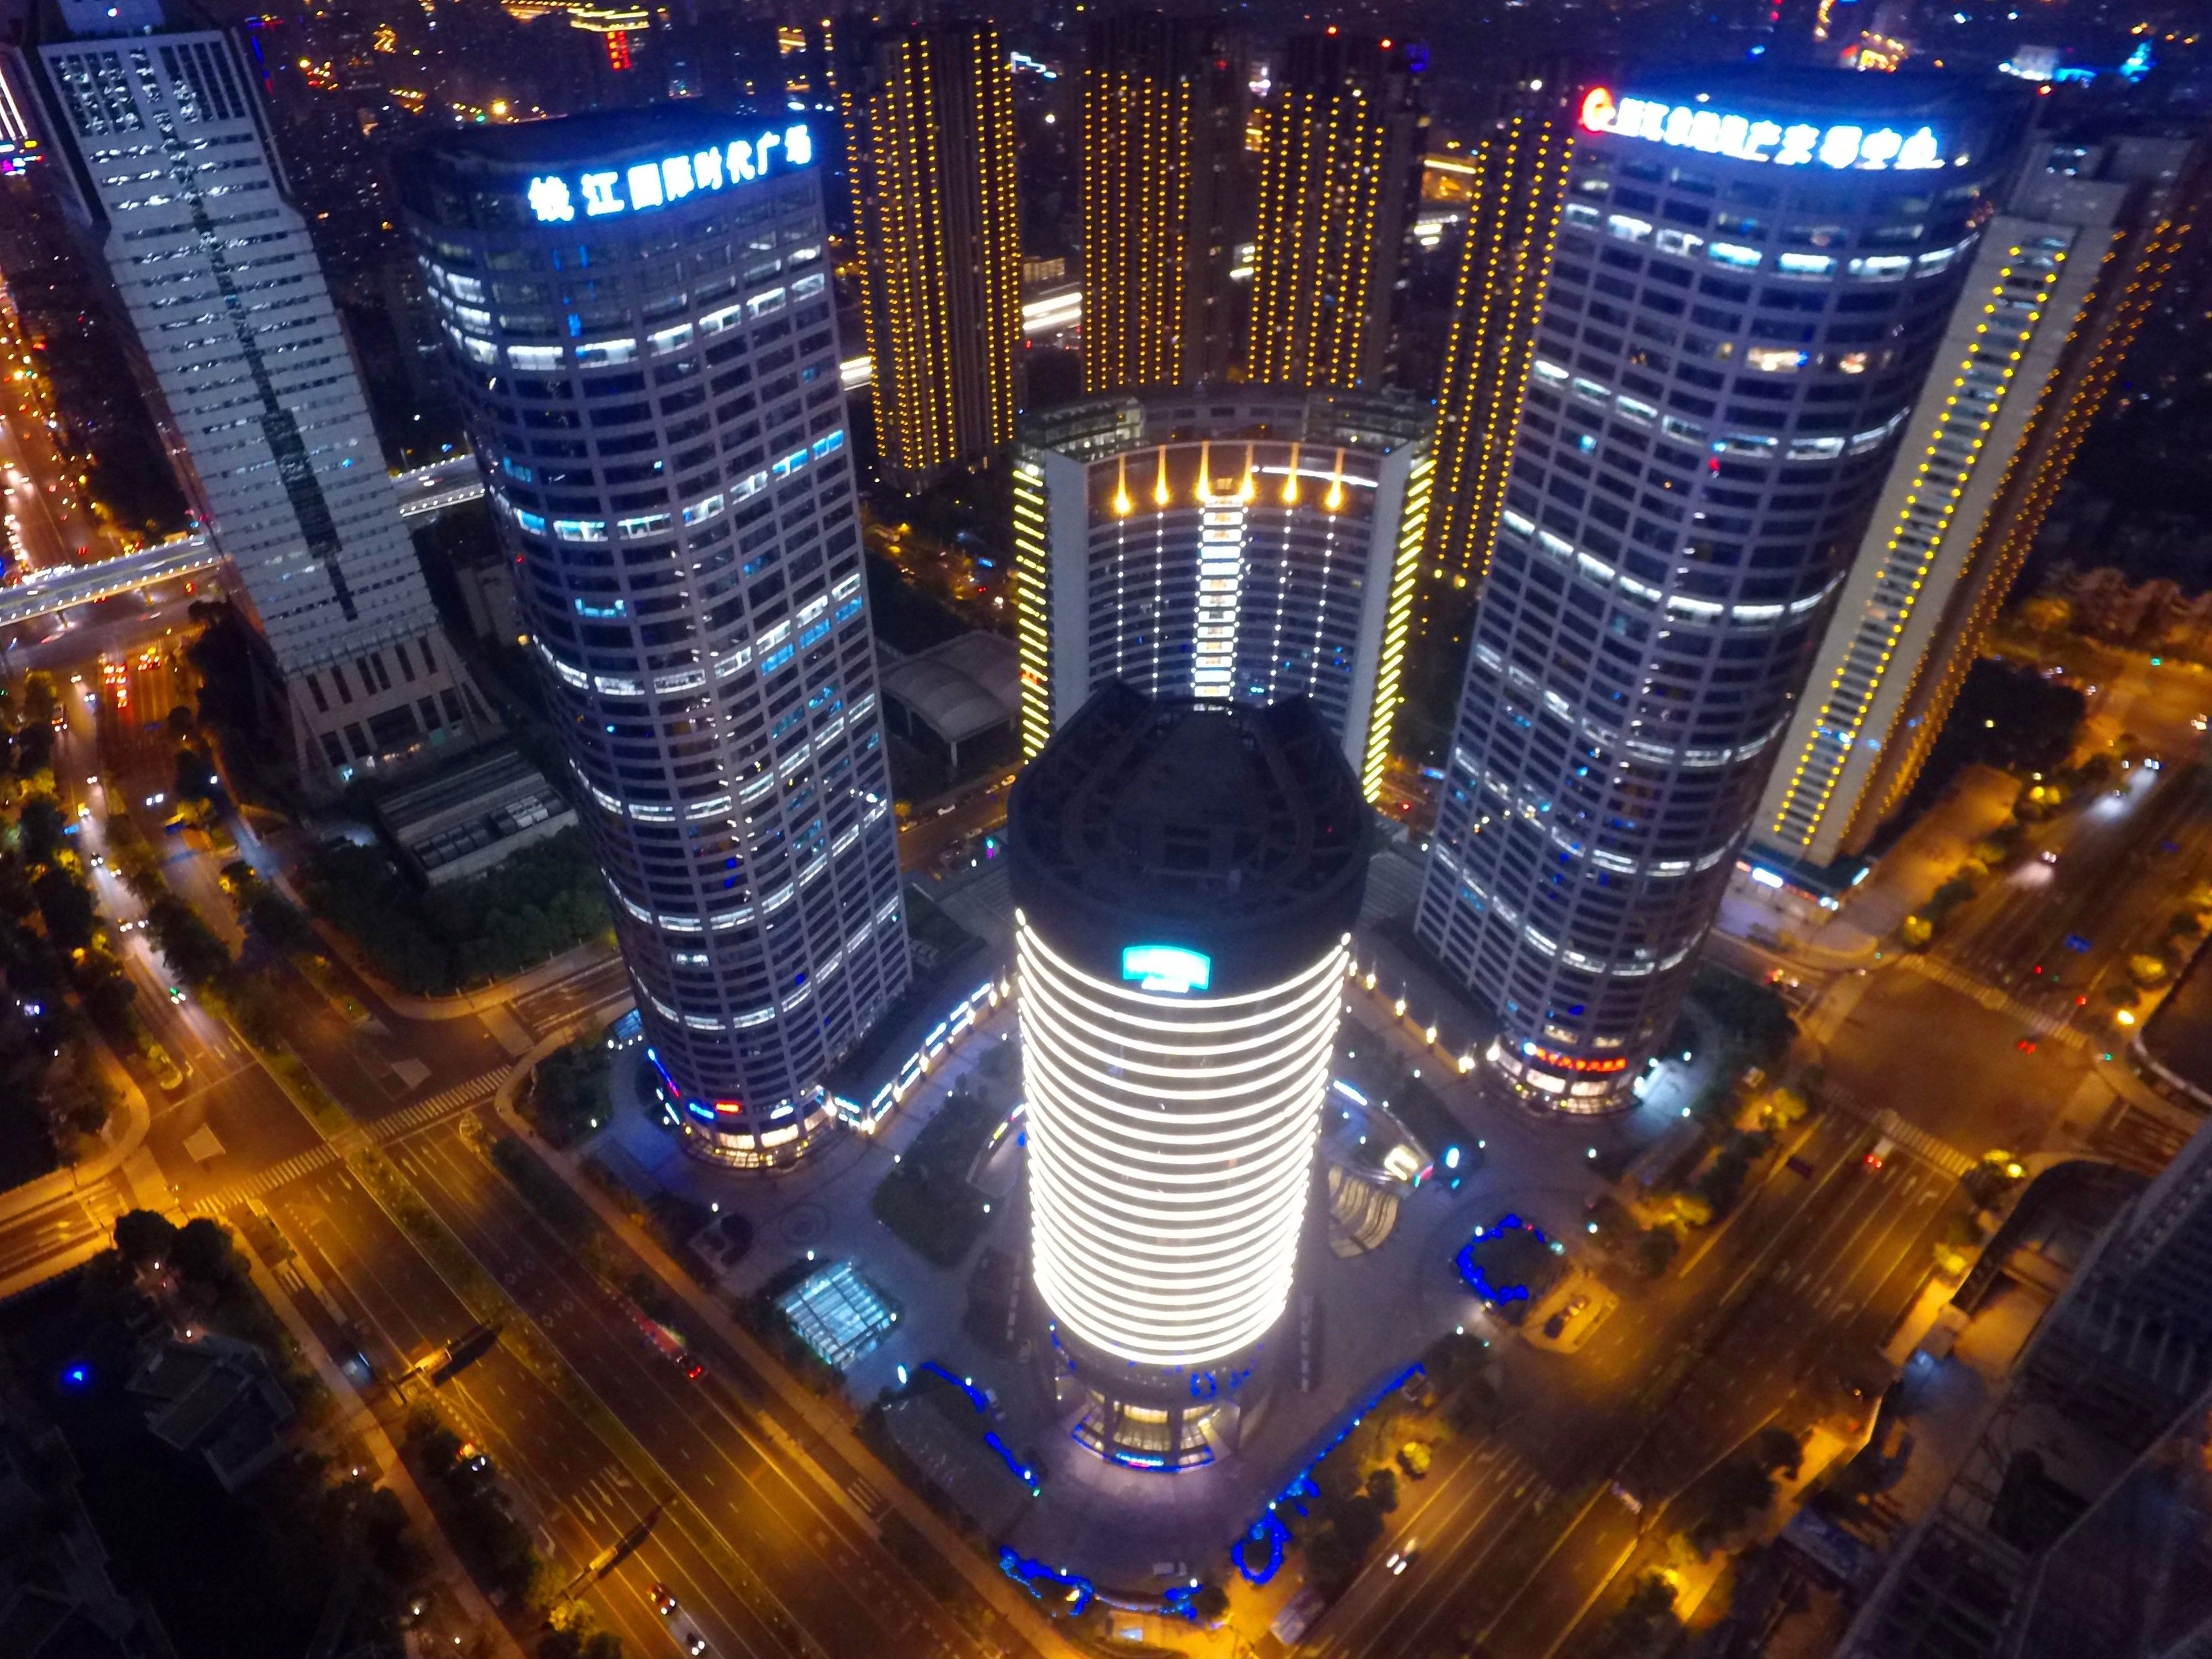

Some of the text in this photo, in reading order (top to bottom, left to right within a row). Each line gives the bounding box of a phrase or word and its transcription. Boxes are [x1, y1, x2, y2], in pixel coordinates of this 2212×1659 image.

[528, 124, 812, 222] 钱江国际时代广场
